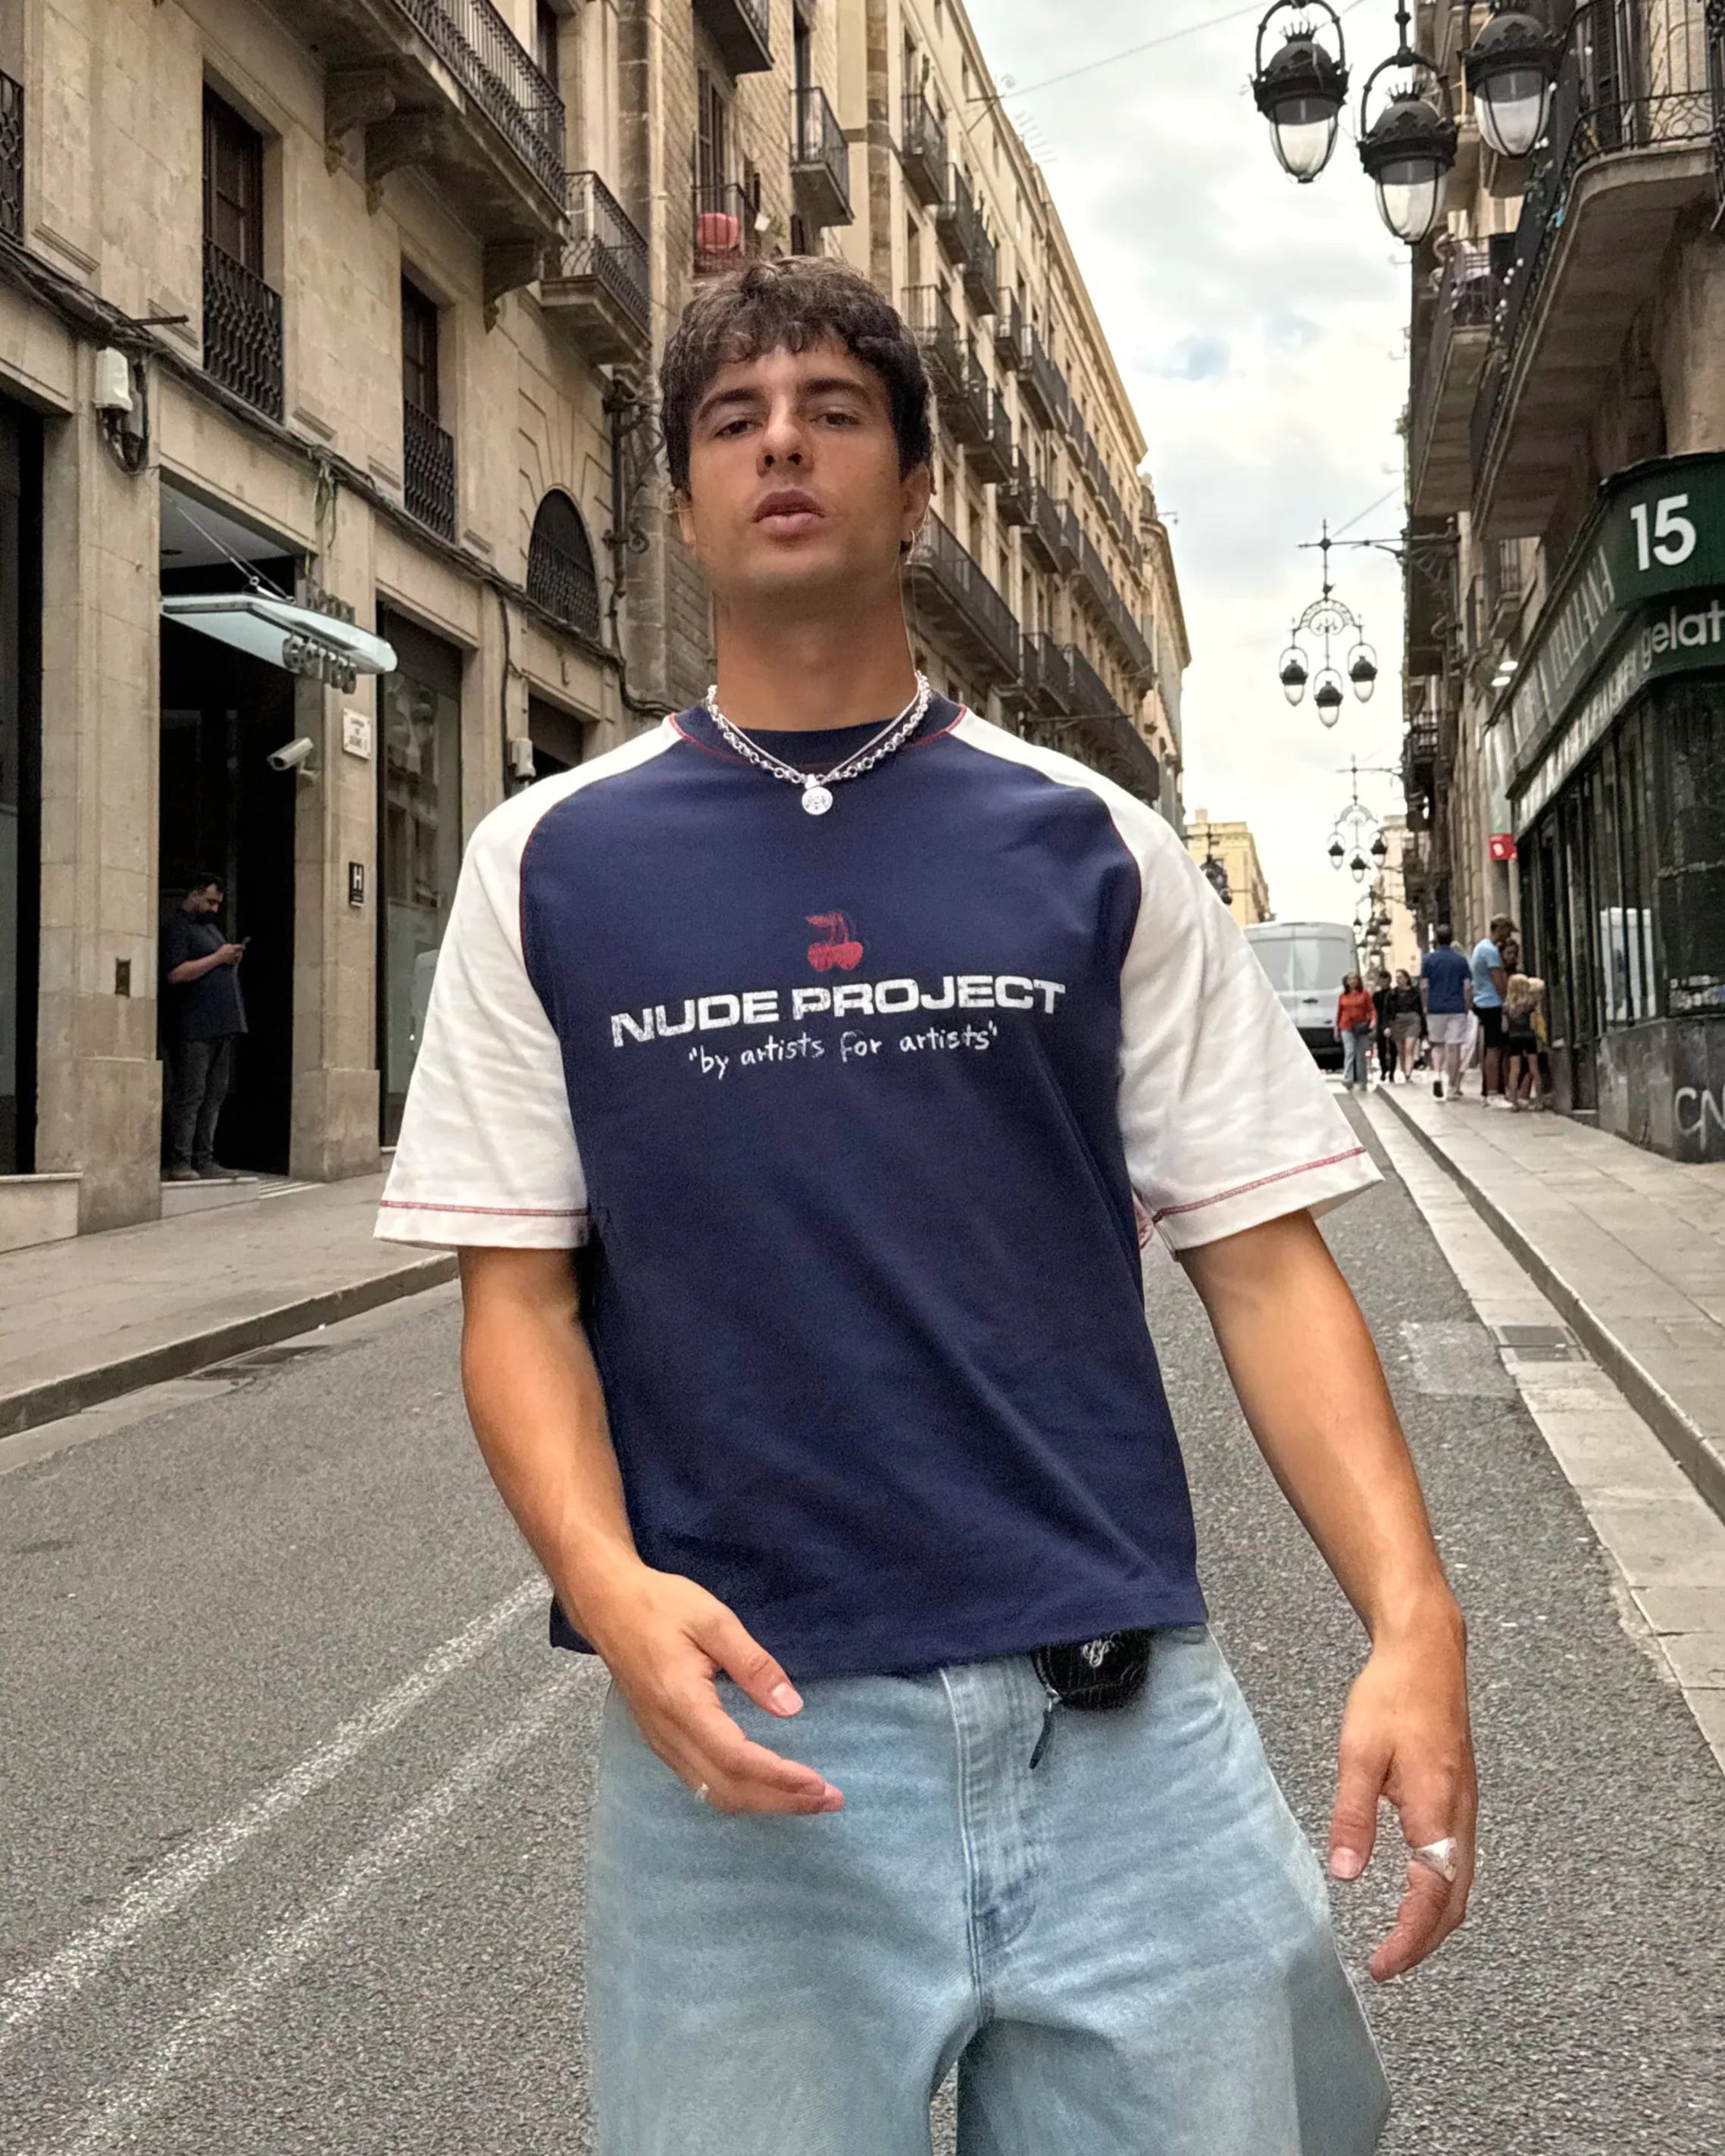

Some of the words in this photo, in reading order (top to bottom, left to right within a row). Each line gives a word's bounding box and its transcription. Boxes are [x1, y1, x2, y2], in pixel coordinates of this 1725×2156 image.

[1630, 493, 1696, 571] 15
[1641, 599, 1725, 672] gelat
[353, 865, 362, 890] H
[611, 989, 780, 1048] NUDE
[792, 975, 1065, 1020] PROJECT
[740, 1031, 825, 1066] artists
[839, 1030, 883, 1063] for
